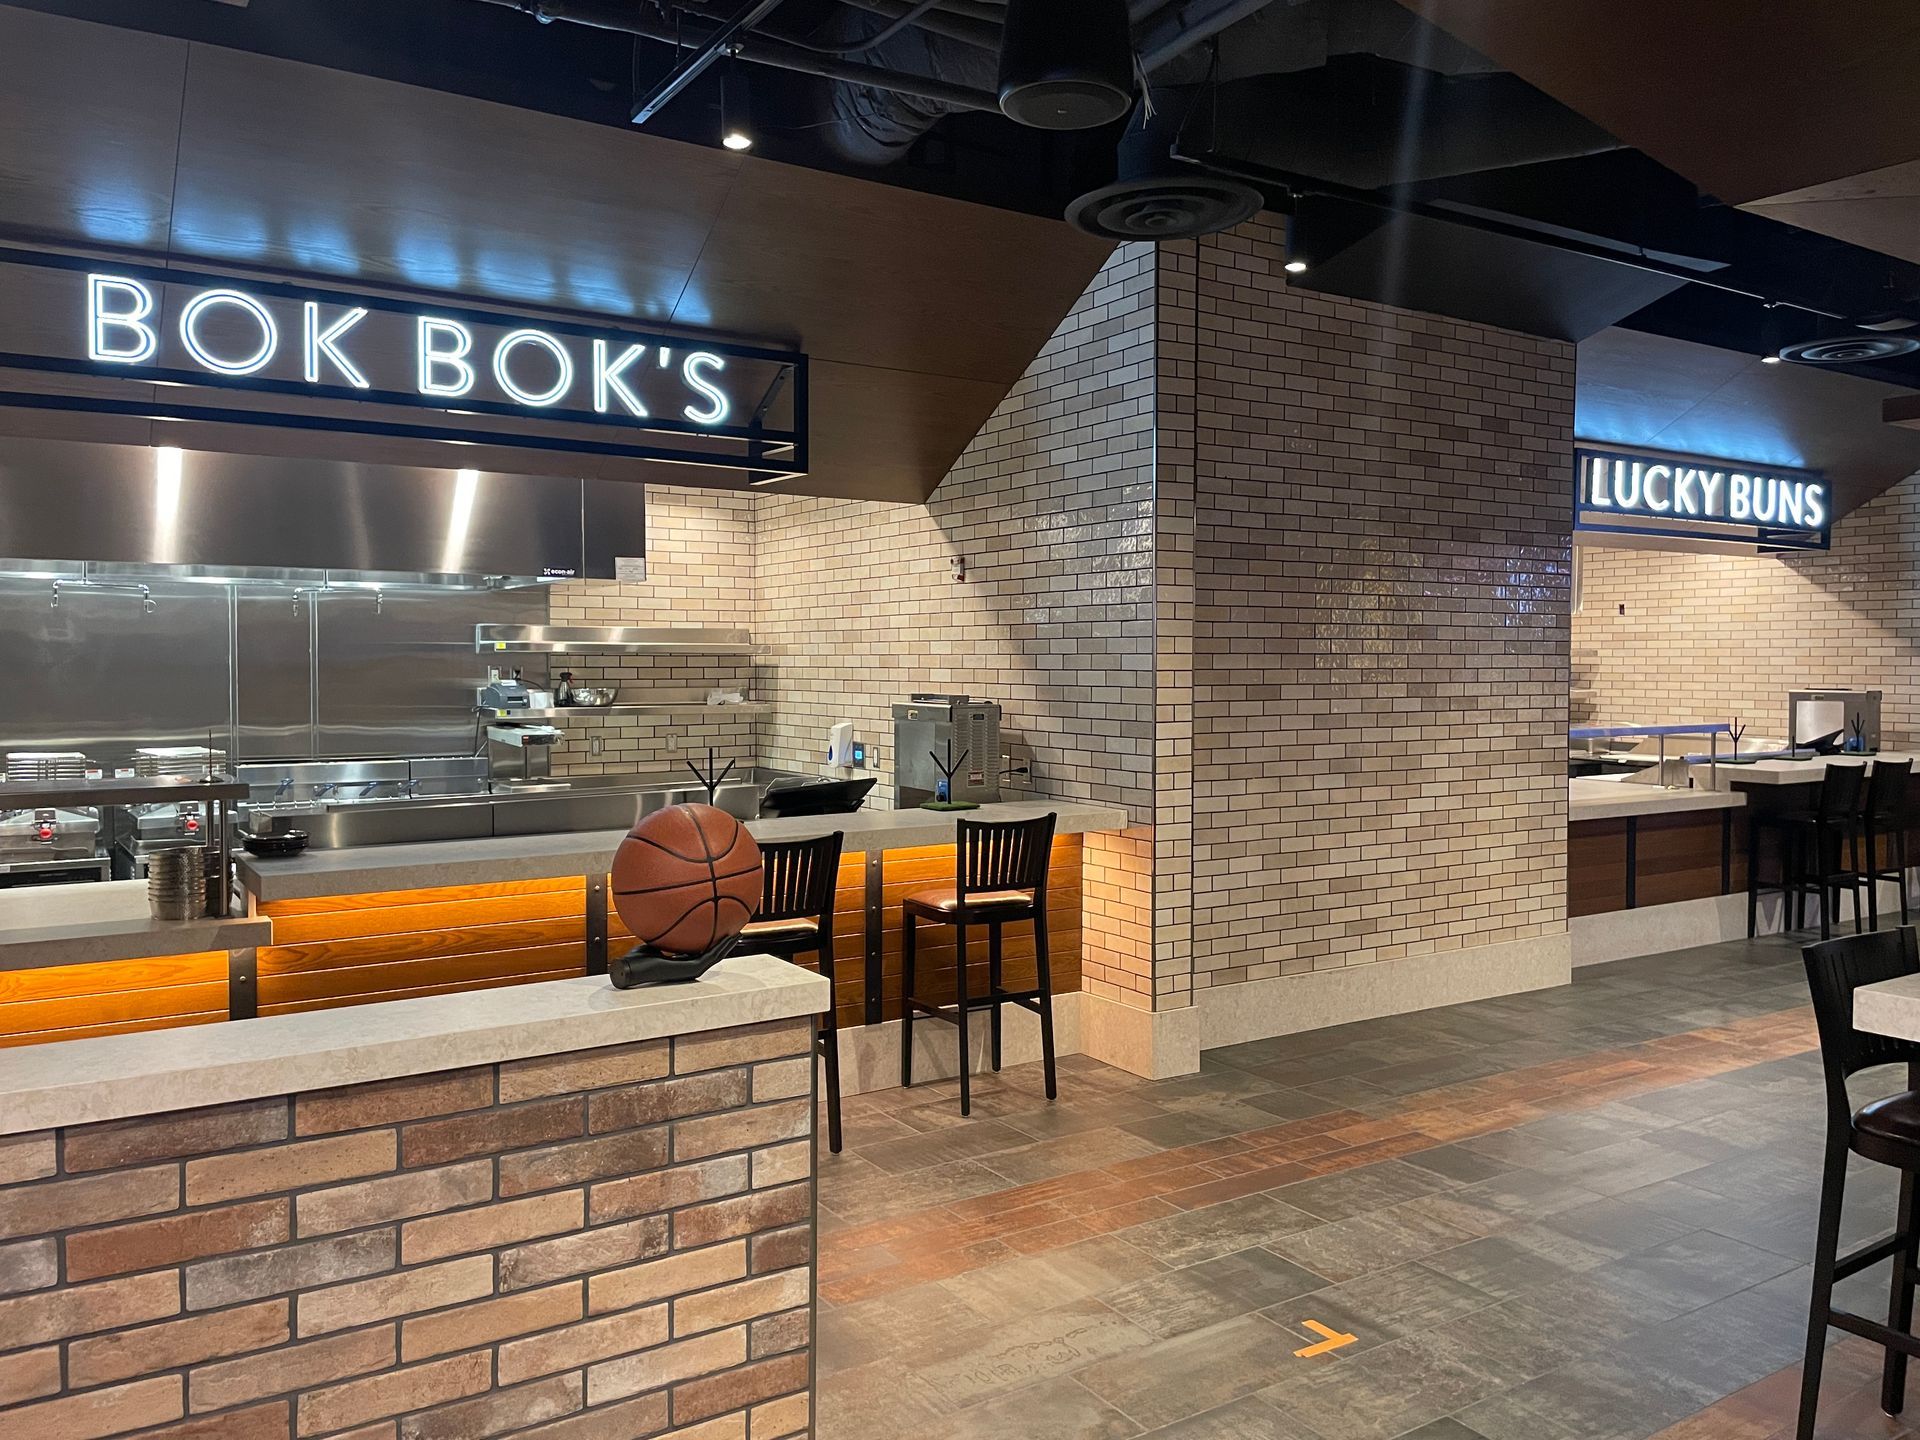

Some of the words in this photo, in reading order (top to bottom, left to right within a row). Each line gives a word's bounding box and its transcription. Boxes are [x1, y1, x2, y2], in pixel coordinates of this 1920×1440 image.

[88, 273, 370, 389] BOK
[417, 315, 728, 424] BOK'S
[1591, 457, 1722, 516] LUCKY
[1729, 473, 1824, 527] BUNS
